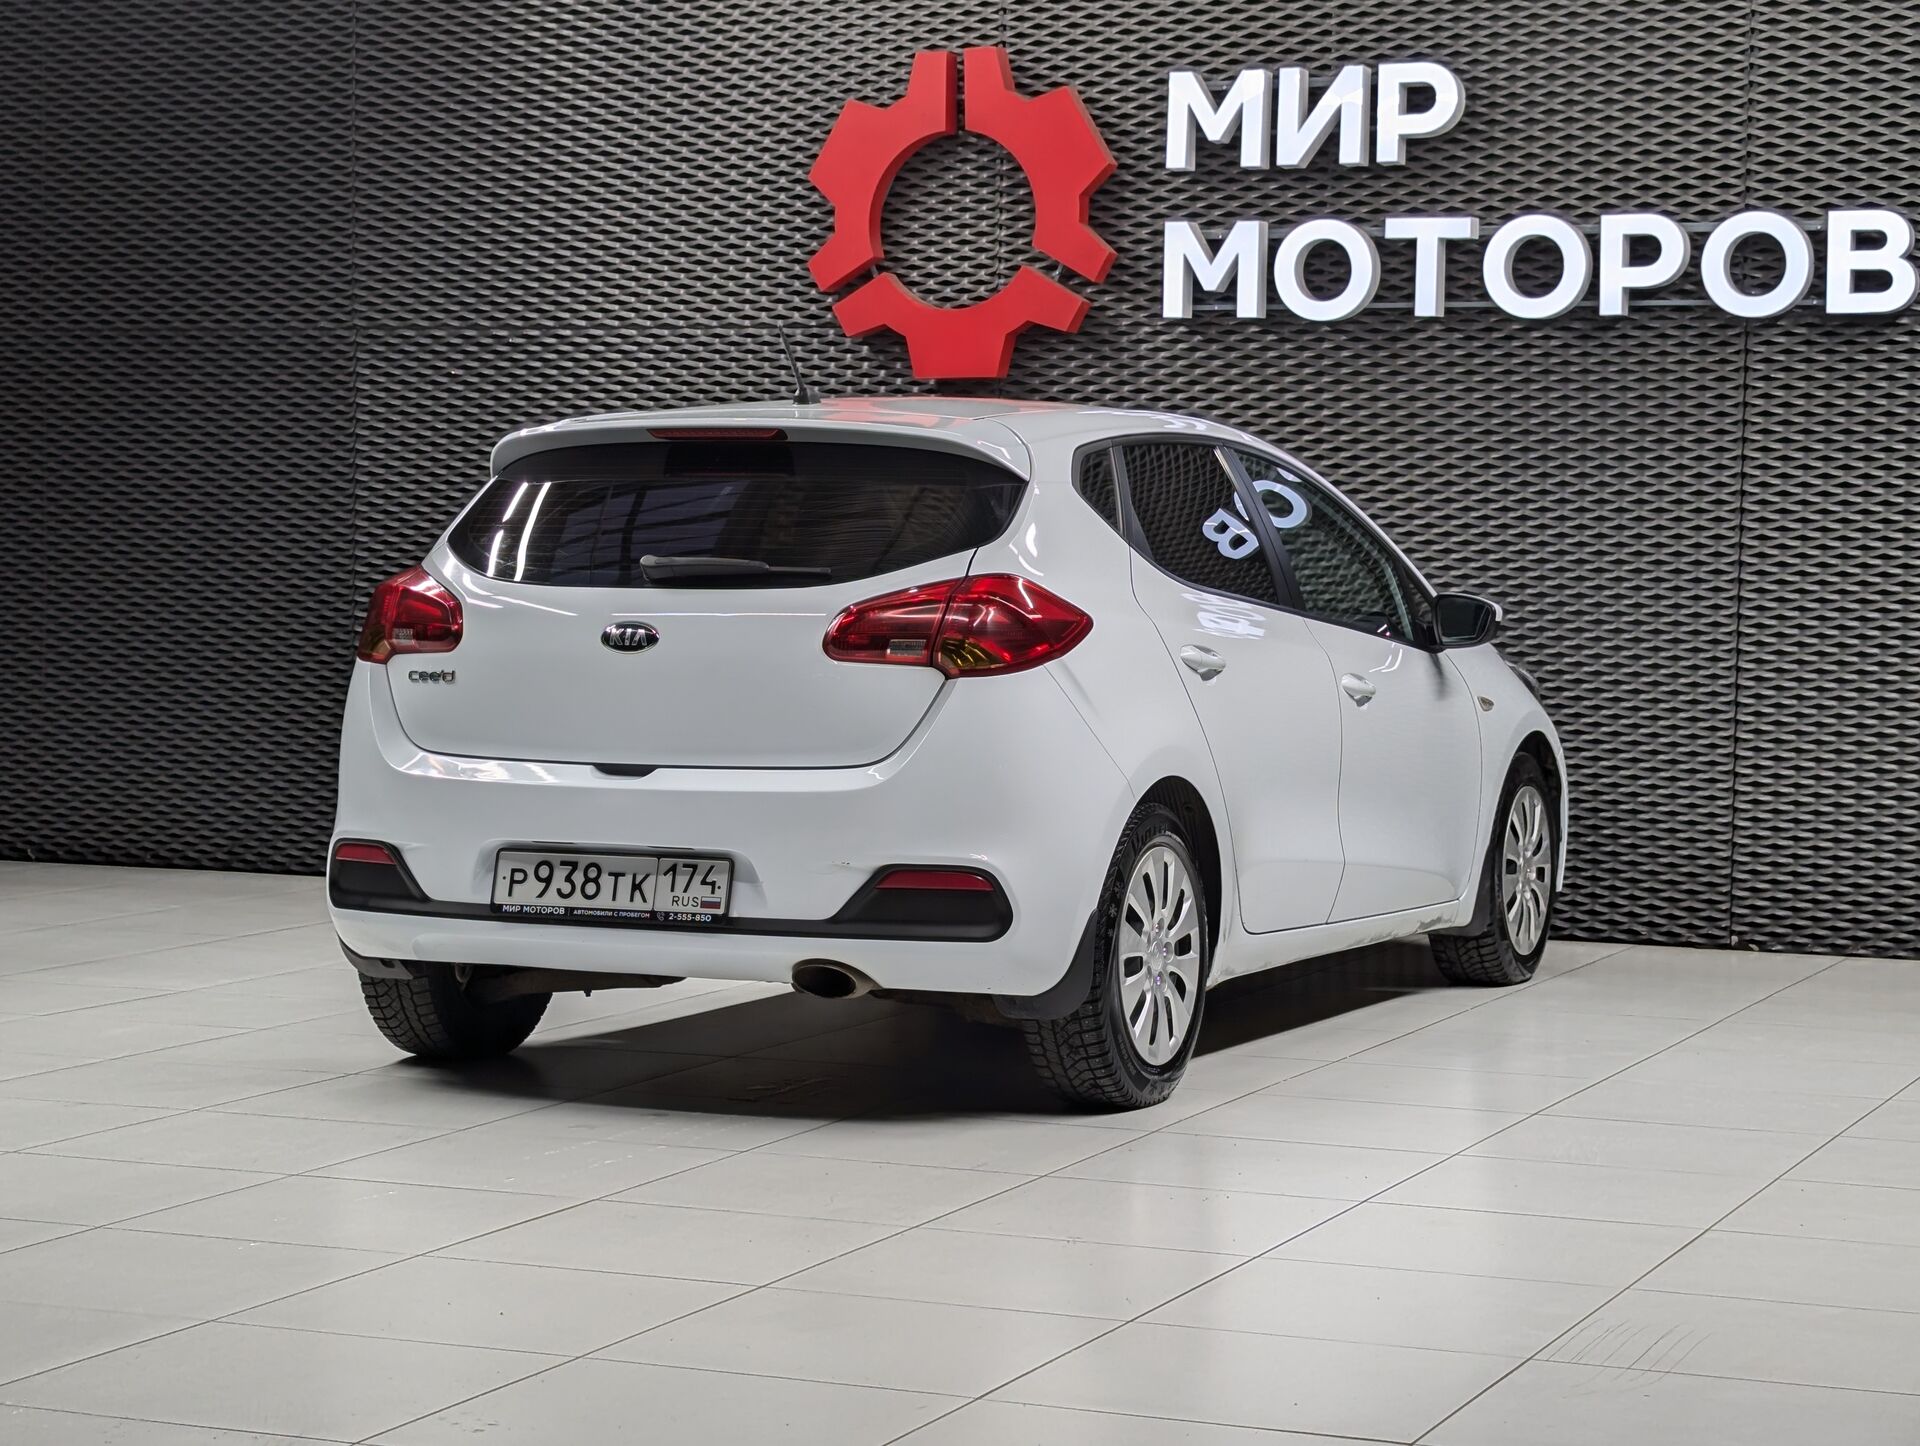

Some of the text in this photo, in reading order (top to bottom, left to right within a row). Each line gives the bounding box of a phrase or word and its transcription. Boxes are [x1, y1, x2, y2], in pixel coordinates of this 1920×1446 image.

[1164, 61, 1466, 171] МИР
[1162, 209, 1917, 321] МОТОРОВ
[608, 628, 648, 646] KIA
[408, 668, 456, 683] cee'd
[662, 863, 718, 895] 174
[671, 895, 699, 908] RUS
[502, 904, 521, 913] МИР
[522, 905, 565, 915] МОТОРОВ
[573, 909, 612, 917] АВТОМОБИЛИ
[668, 912, 712, 922] 2-555-850
